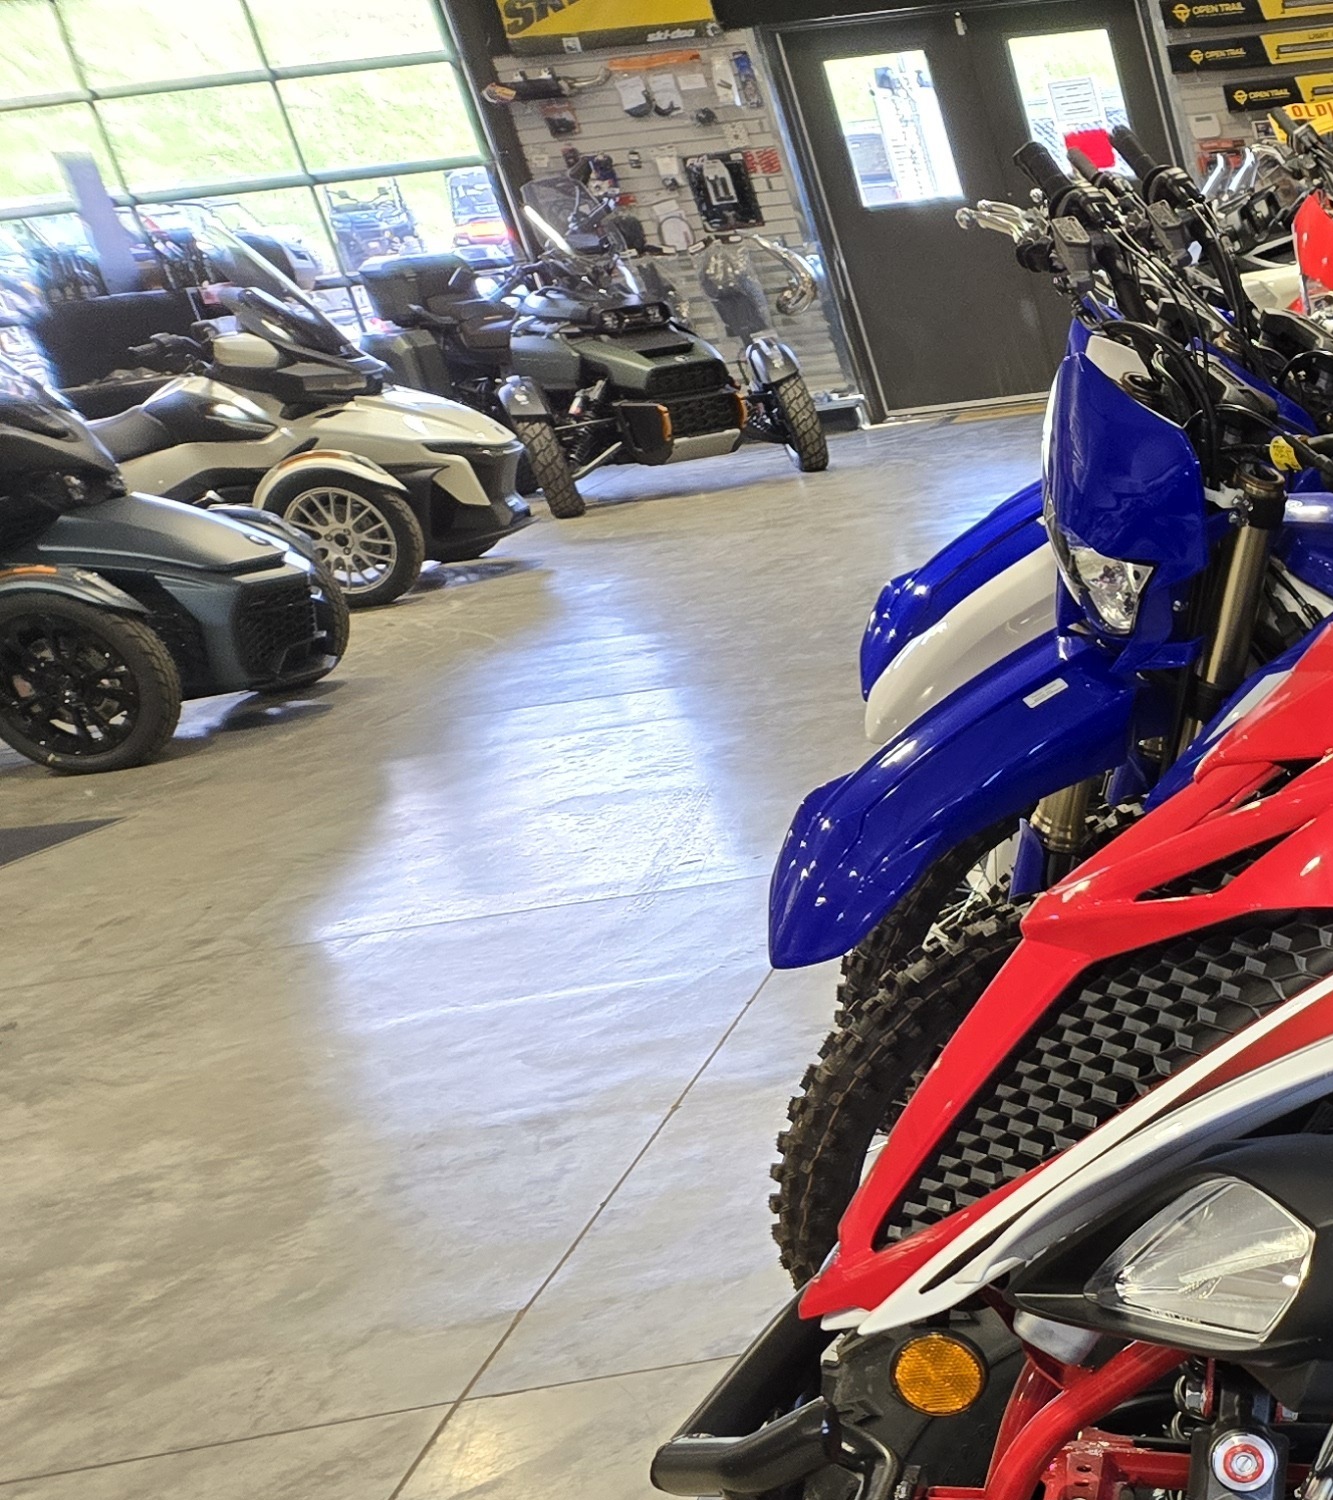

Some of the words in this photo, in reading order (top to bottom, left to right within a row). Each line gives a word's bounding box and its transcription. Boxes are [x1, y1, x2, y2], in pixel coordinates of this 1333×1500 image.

[1192, 5, 1218, 16] OPEN
[1219, 1, 1246, 13] TRAIL
[1205, 49, 1226, 59] OPEN
[1226, 47, 1246, 57] TRAIL
[1249, 91, 1270, 100] OPEN
[1270, 88, 1291, 98] TRAIL
[1291, 104, 1328, 118] OLD
